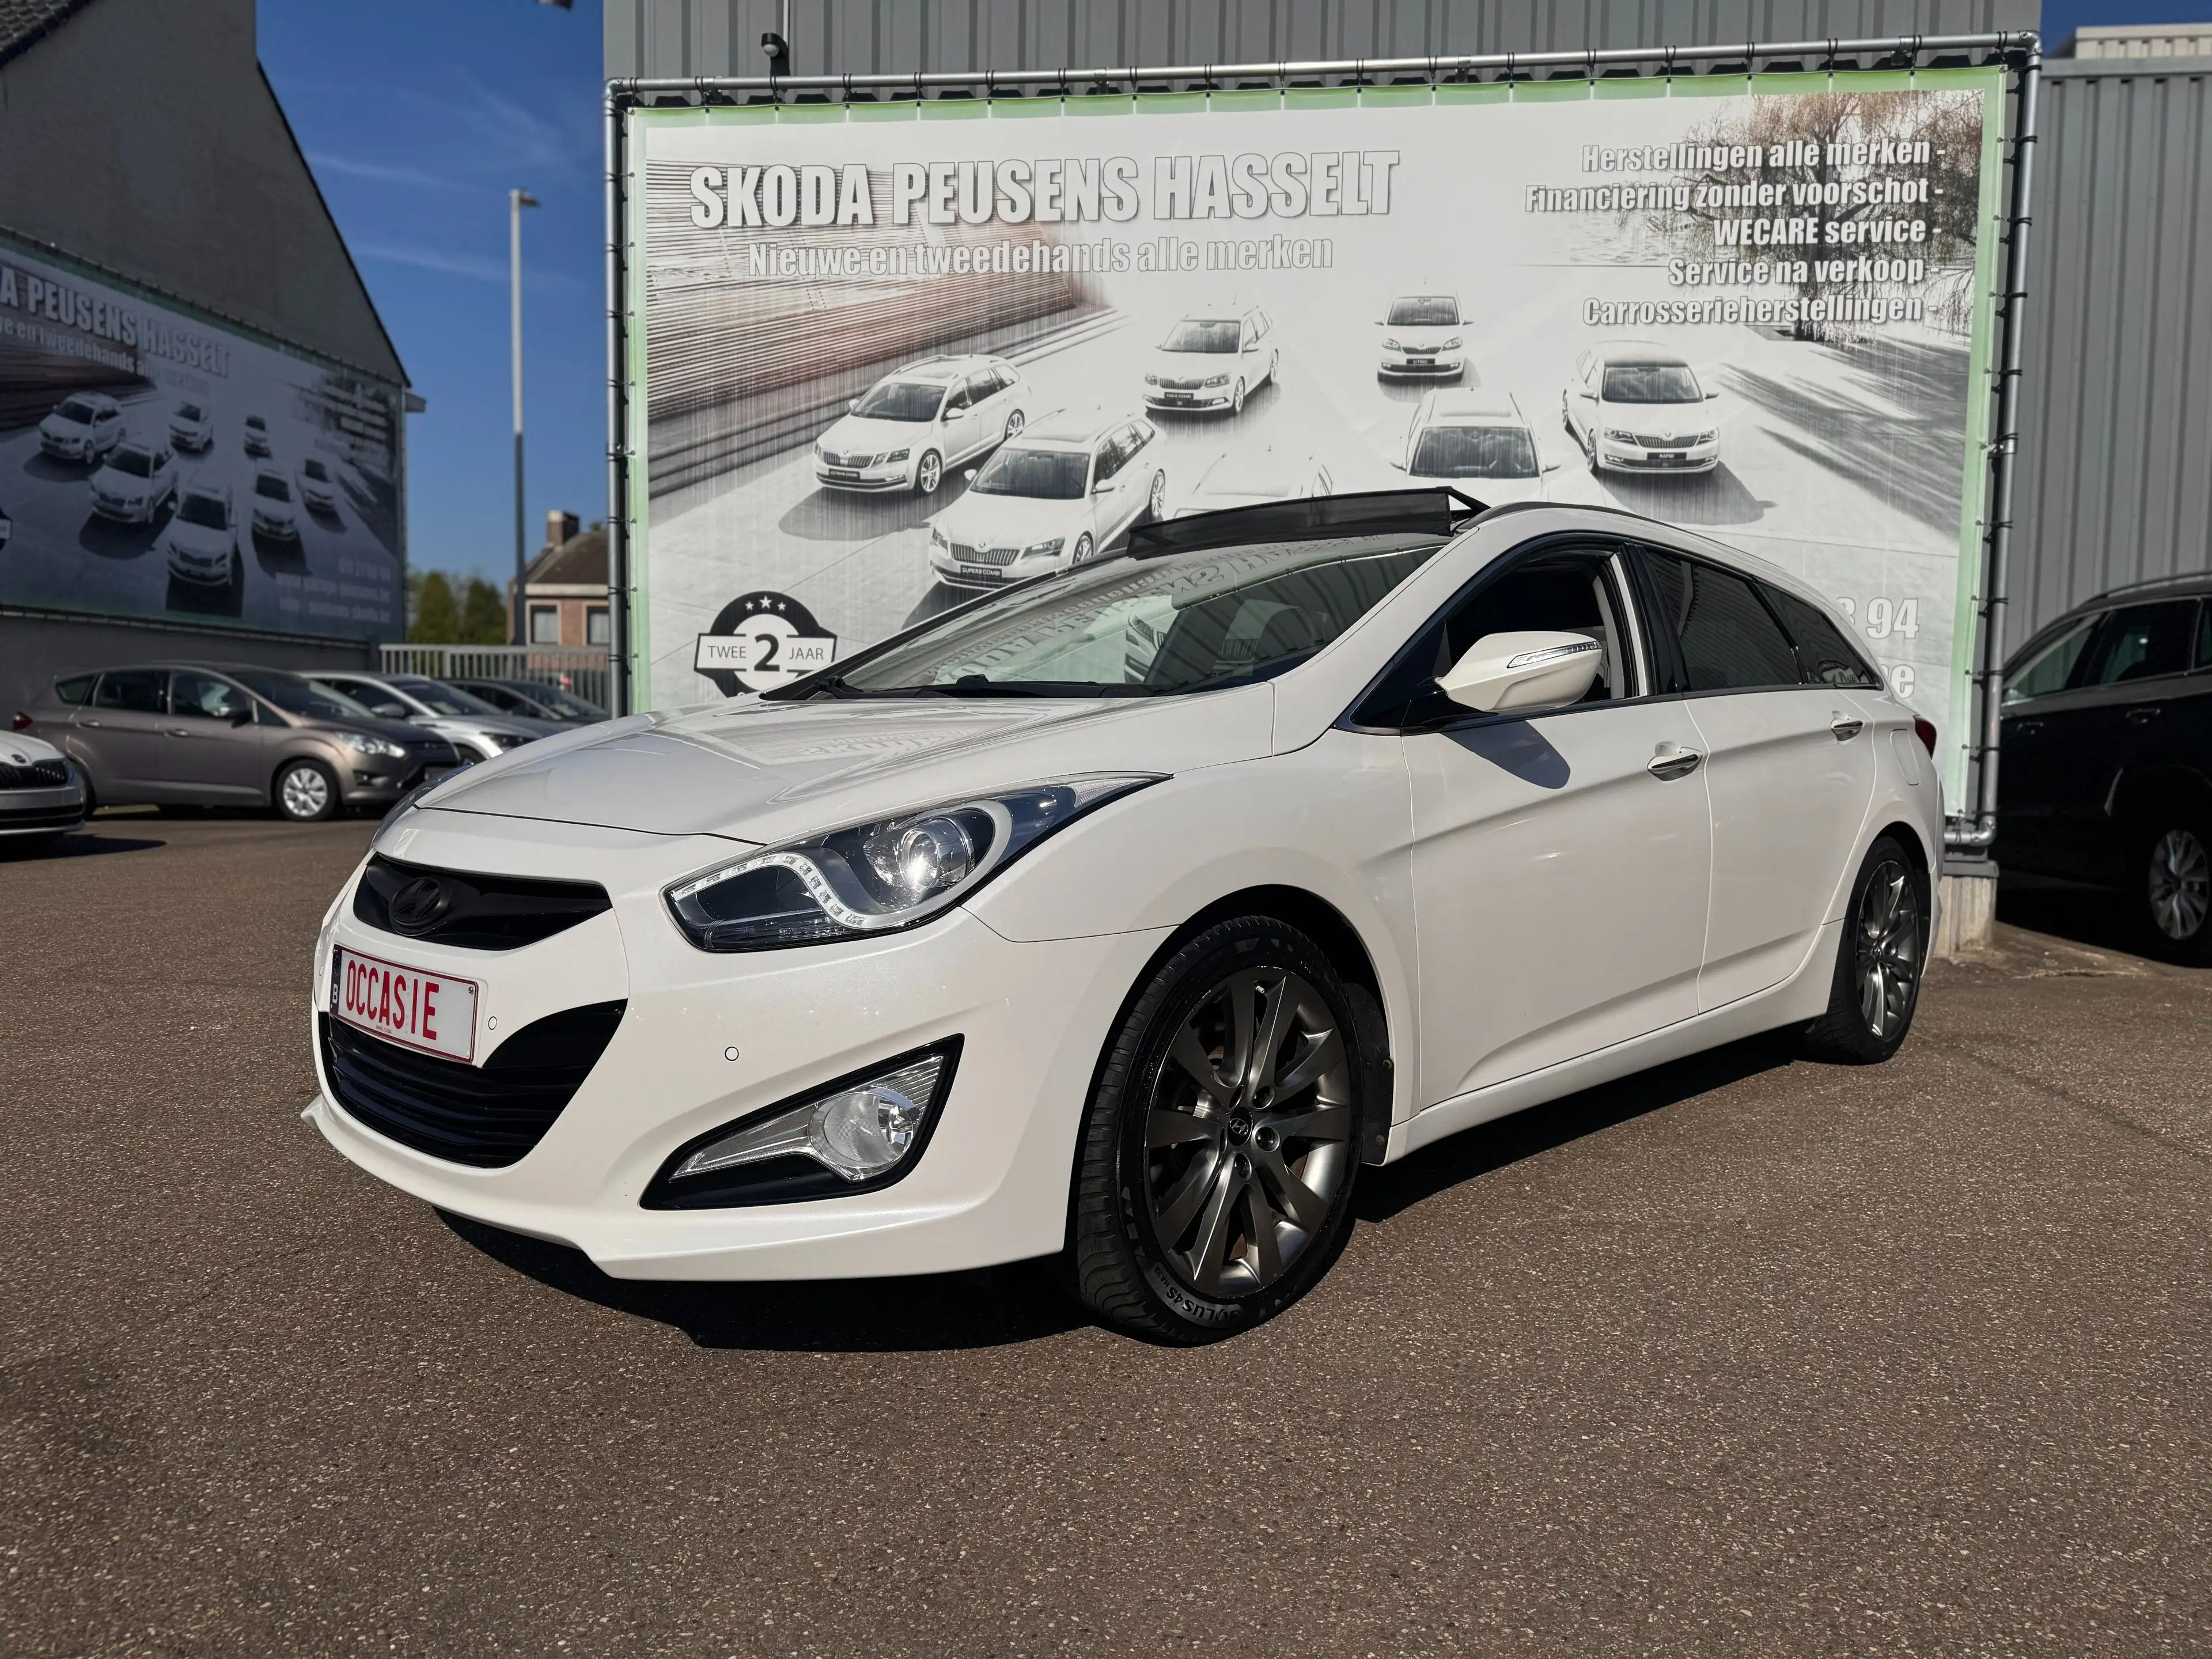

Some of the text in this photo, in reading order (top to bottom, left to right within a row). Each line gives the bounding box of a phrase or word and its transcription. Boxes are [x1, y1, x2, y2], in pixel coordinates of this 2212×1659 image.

[1581, 142, 1763, 172] Herstellingen
[1768, 140, 1819, 168] alle
[1826, 138, 1930, 166] merken
[690, 150, 1400, 228] SKODA PEUSENS HASSELT
[1525, 183, 1690, 211] Financiering
[1695, 180, 1787, 208] zonder
[1793, 177, 1929, 205] voorschot
[1713, 217, 1819, 246] WECARE
[1824, 215, 1927, 243] service
[749, 234, 1333, 276] Nieuwe en tweedehands alle merken
[1668, 257, 1769, 285] Service
[1774, 261, 1809, 284] na
[1814, 255, 1924, 285] verkoop
[1582, 295, 1922, 325] Carrosserieherstellingen
[28, 277, 137, 348] PEUSENS
[140, 315, 231, 379] HASSELT
[38, 324, 135, 373] tweedehands
[707, 633, 824, 672] TWEE 2 JAAR
[332, 983, 339, 1003] B
[346, 960, 440, 1040] OCCASIE
[1165, 1287, 1184, 1304] 4S
